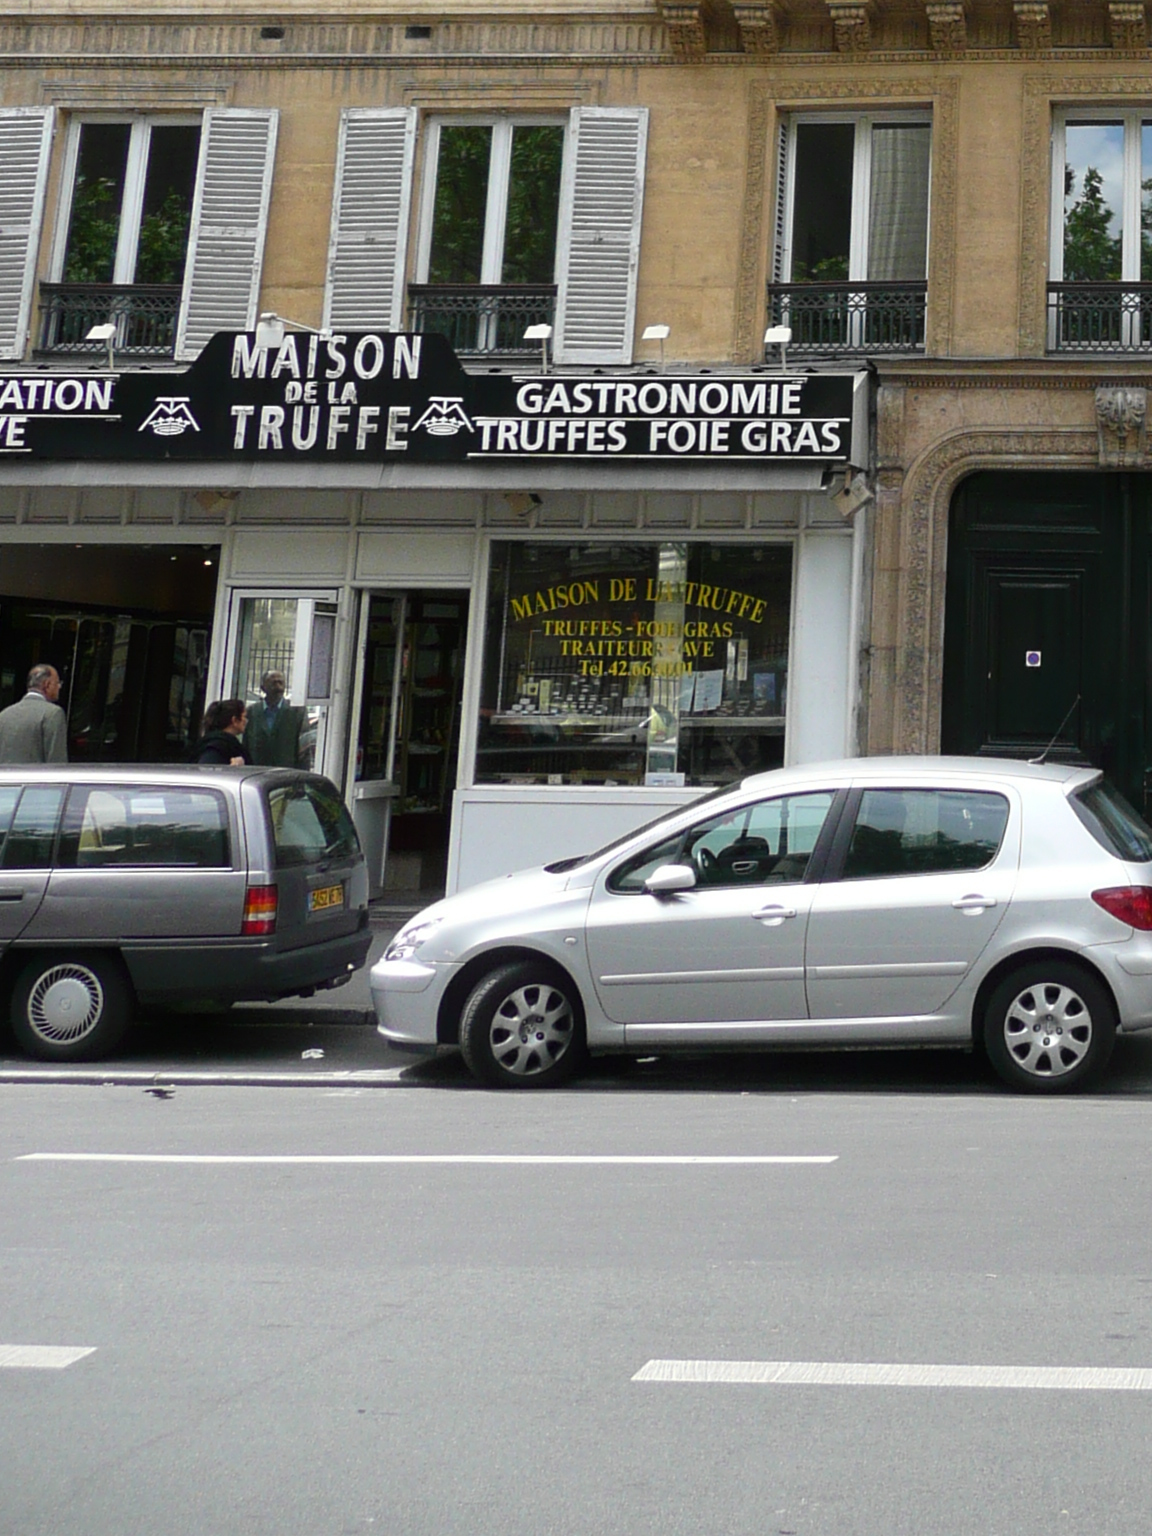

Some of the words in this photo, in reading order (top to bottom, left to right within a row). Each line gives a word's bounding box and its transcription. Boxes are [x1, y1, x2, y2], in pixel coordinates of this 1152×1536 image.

[231, 334, 422, 380] MAISON
[0, 379, 113, 410] ATION
[285, 381, 317, 404] DE
[327, 381, 358, 405] LA
[516, 382, 802, 415] GASTRONOMIE
[230, 405, 412, 450] TRUFFE
[477, 418, 627, 452] TRUFFES
[649, 420, 731, 452] FOIE
[741, 421, 841, 453] GRAS
[510, 580, 599, 622] MAISON
[609, 578, 637, 602] DE
[645, 578, 674, 602] LA
[684, 581, 768, 624] TRUFFE
[542, 620, 622, 637] TRUFFES
[683, 621, 733, 638] GRAS
[559, 639, 653, 657] TRAITEUR
